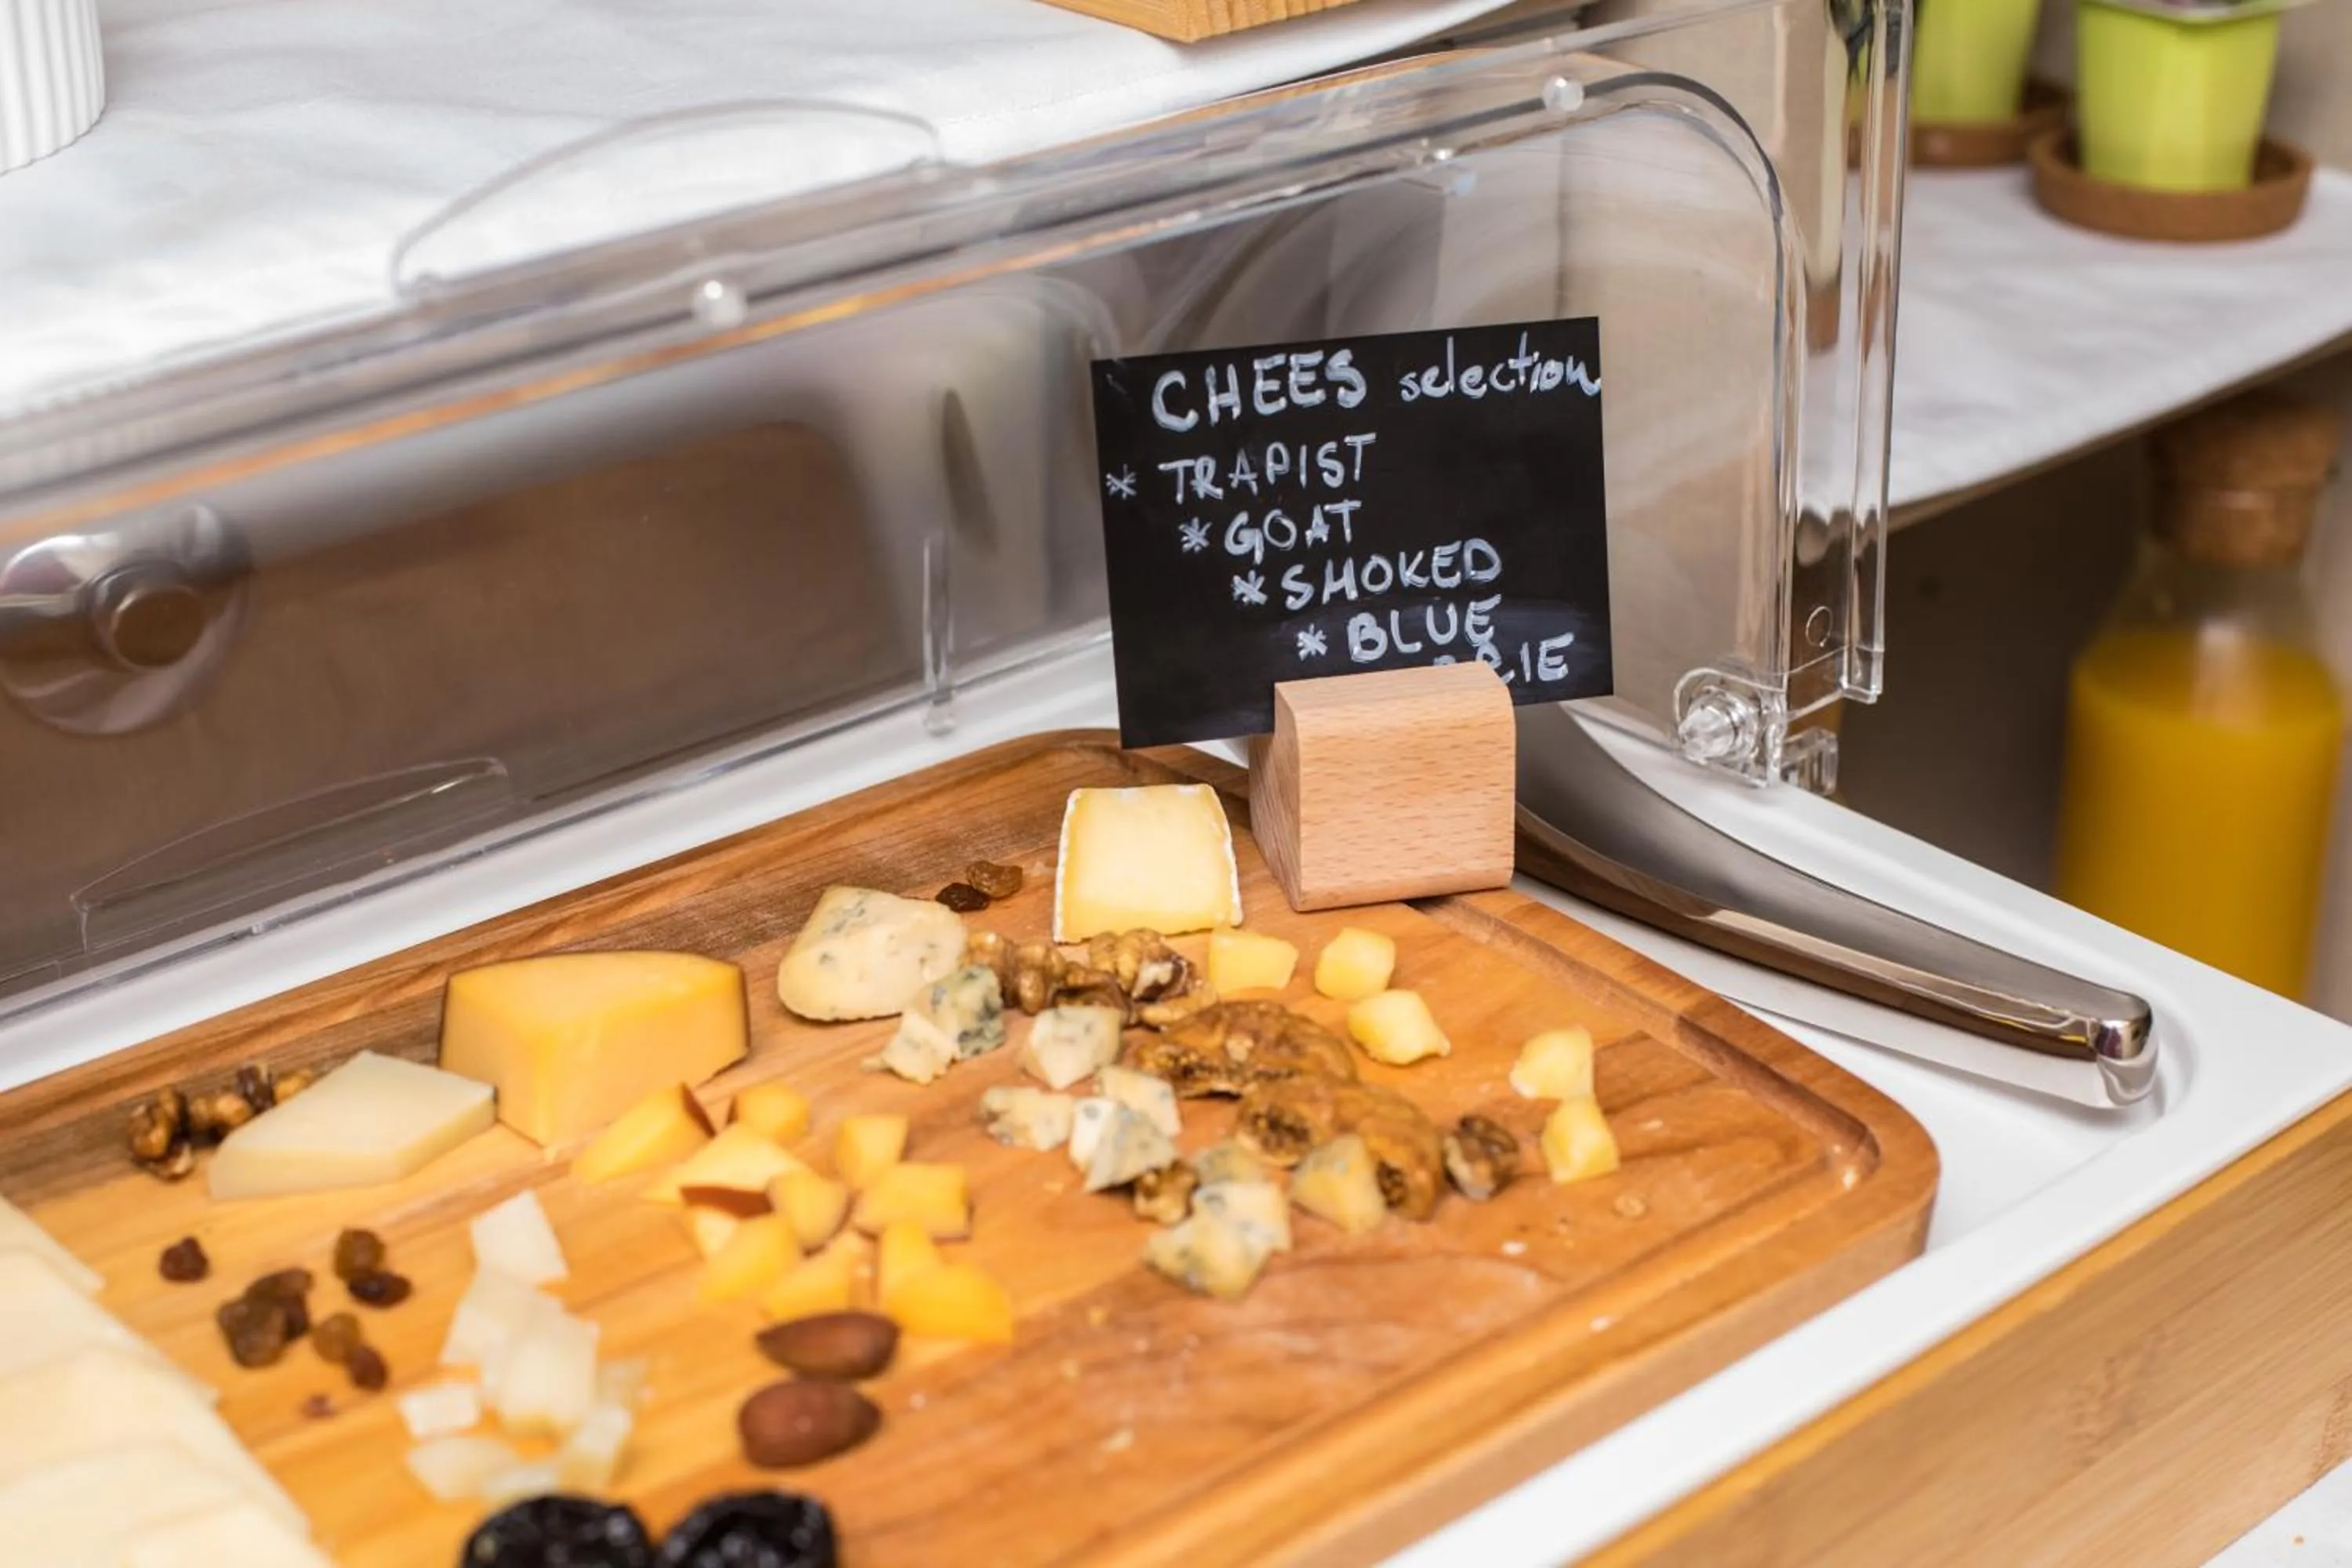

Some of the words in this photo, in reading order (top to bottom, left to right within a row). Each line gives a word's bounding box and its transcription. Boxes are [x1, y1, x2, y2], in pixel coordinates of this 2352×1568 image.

[1152, 348, 1367, 433] CHEES
[1399, 331, 1602, 402] selection
[1158, 432, 1377, 505] TRAPIST
[1224, 499, 1362, 564] GOAT
[1347, 593, 1502, 662] BLUE
[1433, 632, 1575, 684] RIE
